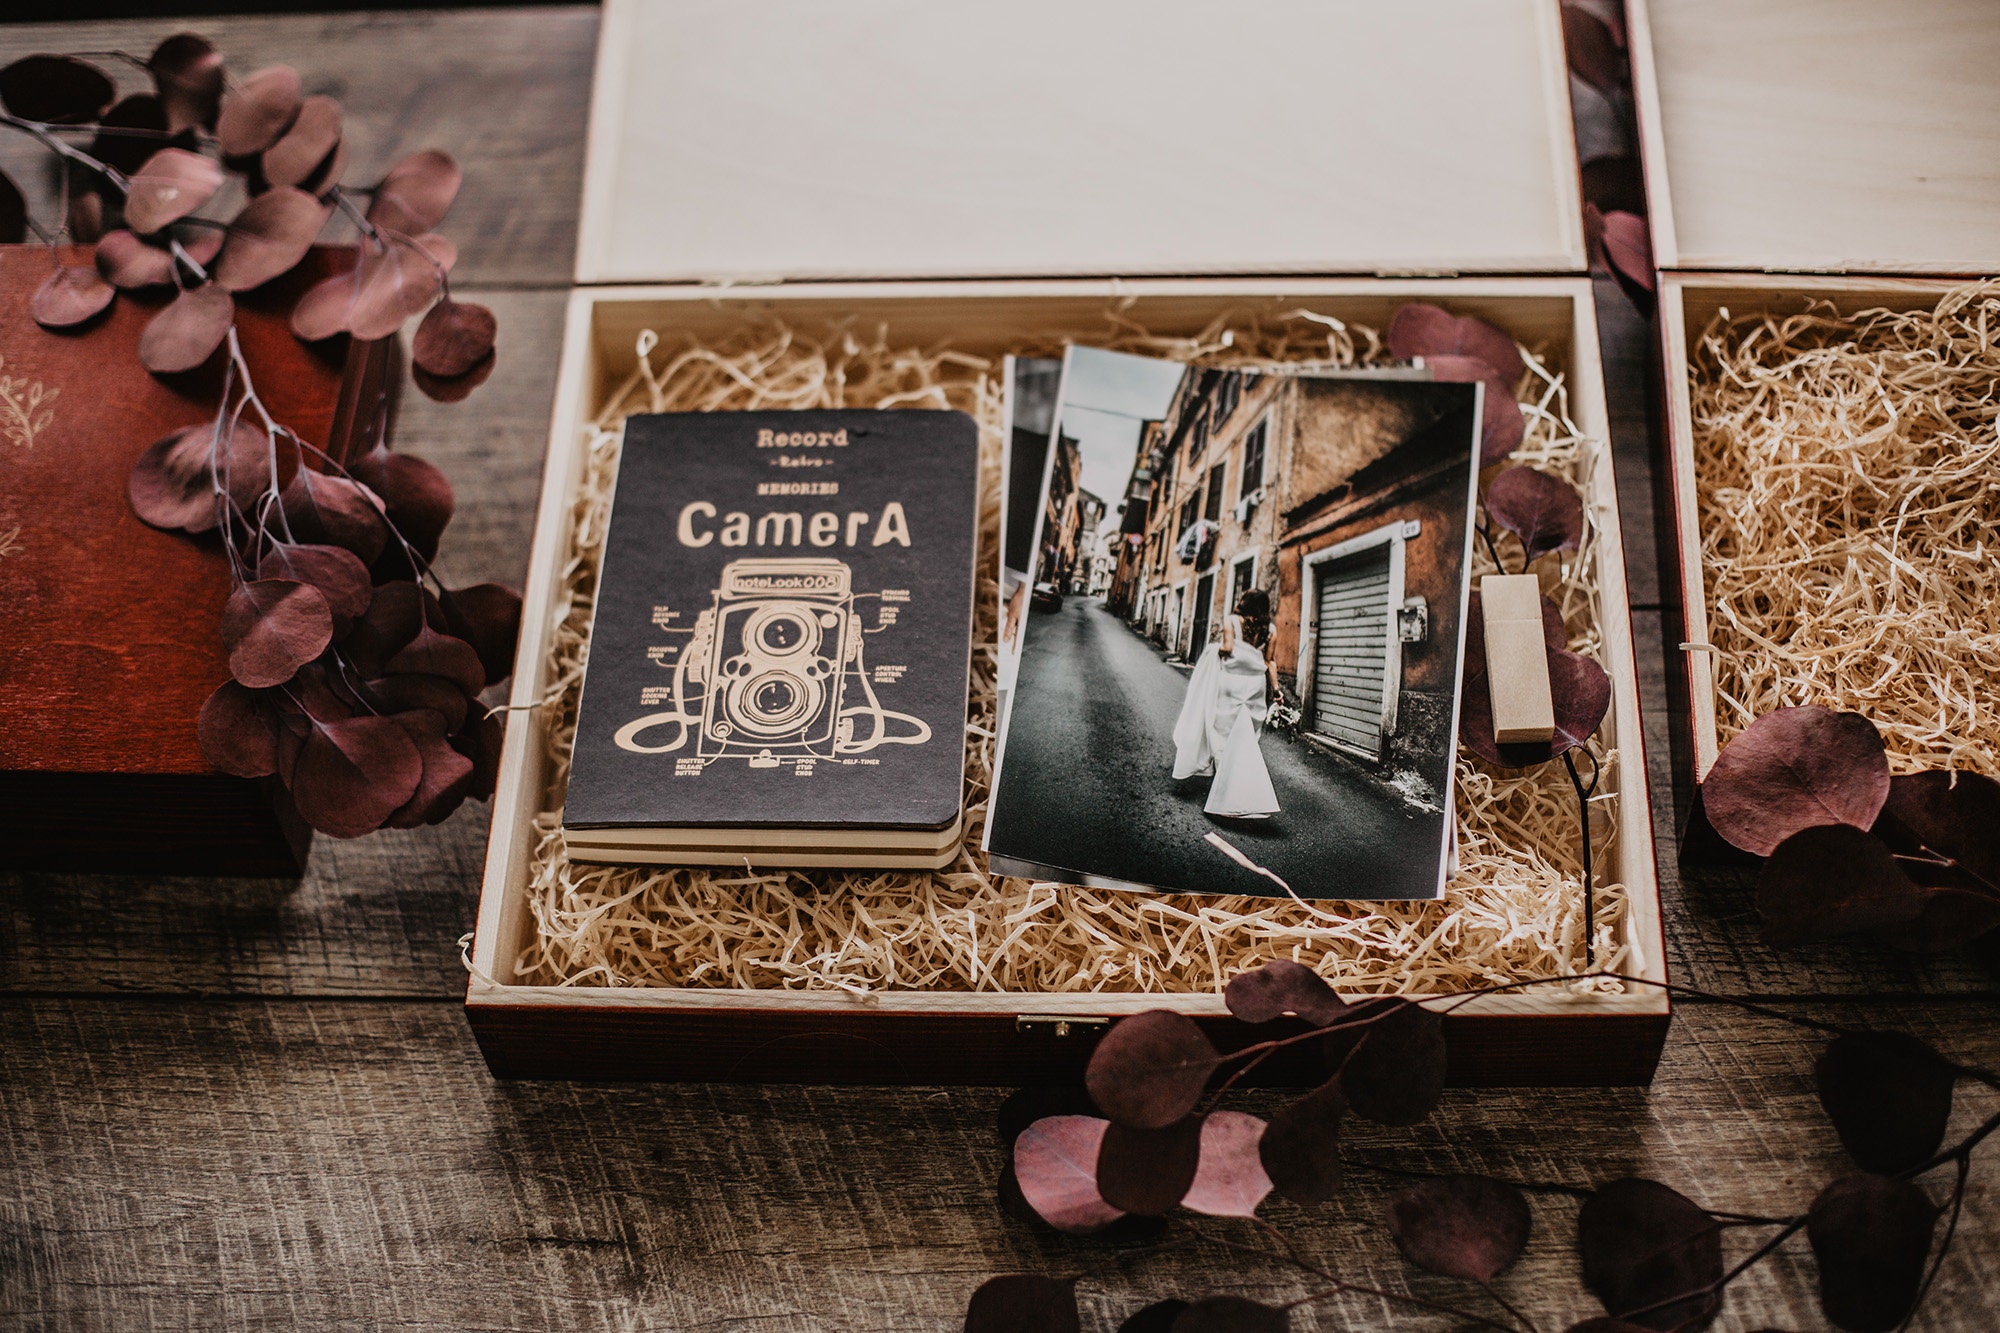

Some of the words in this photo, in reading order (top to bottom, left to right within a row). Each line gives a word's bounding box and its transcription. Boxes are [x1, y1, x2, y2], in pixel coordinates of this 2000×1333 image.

[756, 428, 850, 448] Record
[757, 482, 840, 496] MEMORIES
[676, 500, 912, 548] CamerA
